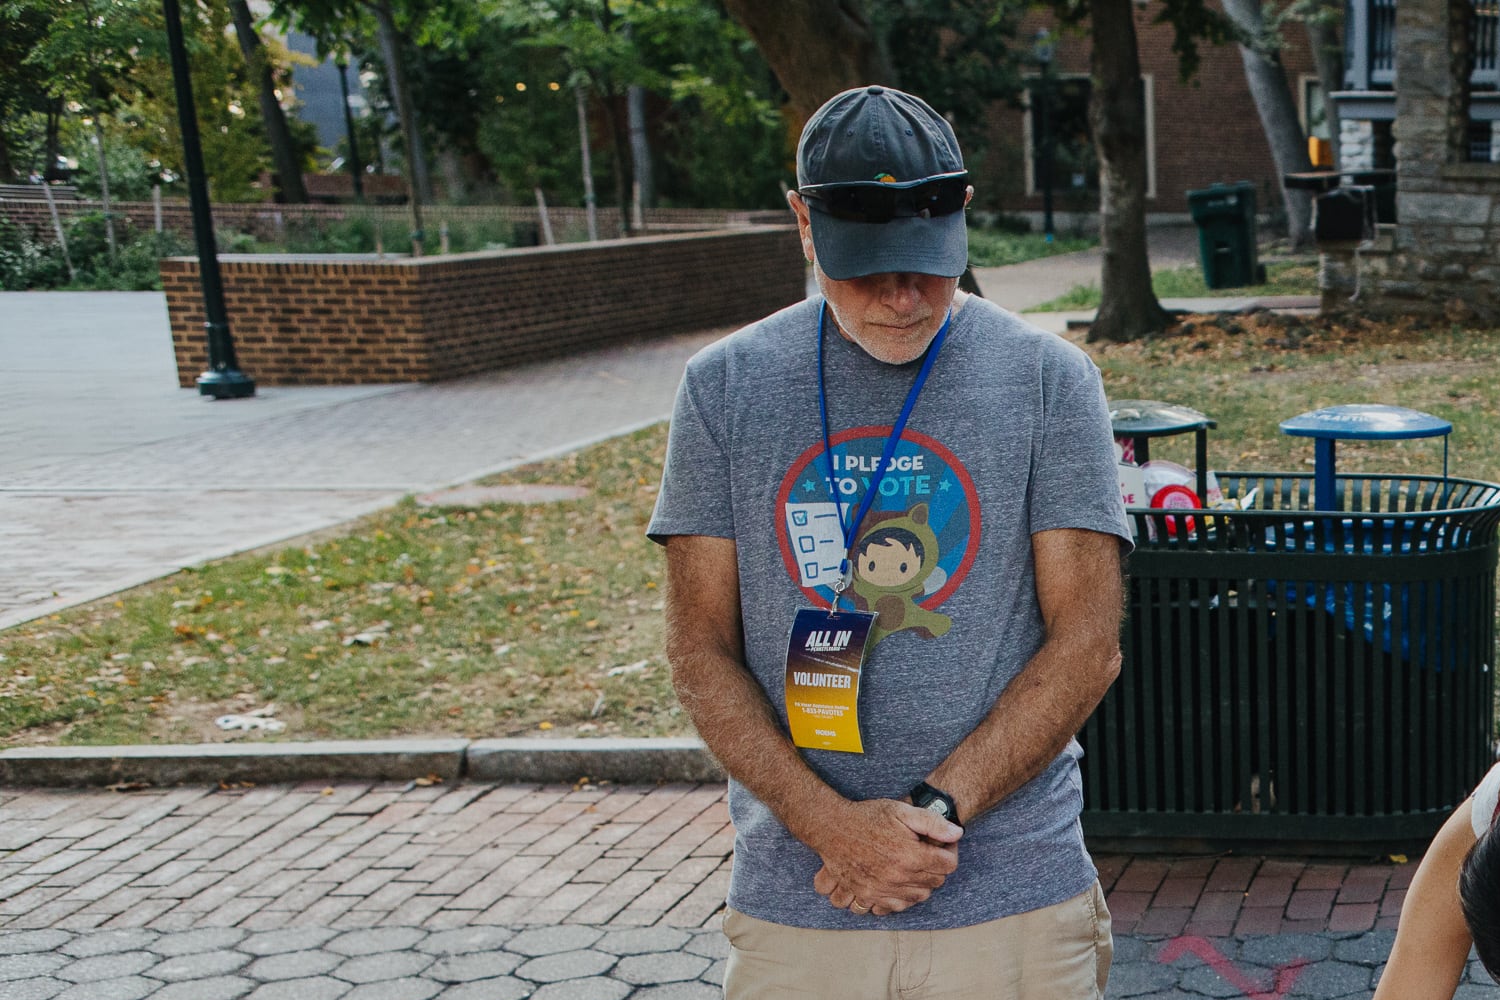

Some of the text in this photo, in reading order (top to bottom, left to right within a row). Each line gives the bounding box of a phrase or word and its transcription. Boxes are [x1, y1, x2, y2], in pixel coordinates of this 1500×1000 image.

[833, 455, 924, 472] I PLEDGE
[825, 476, 858, 495] TO
[805, 630, 853, 648] ALL IN
[793, 671, 852, 689] VOLUNTEER
